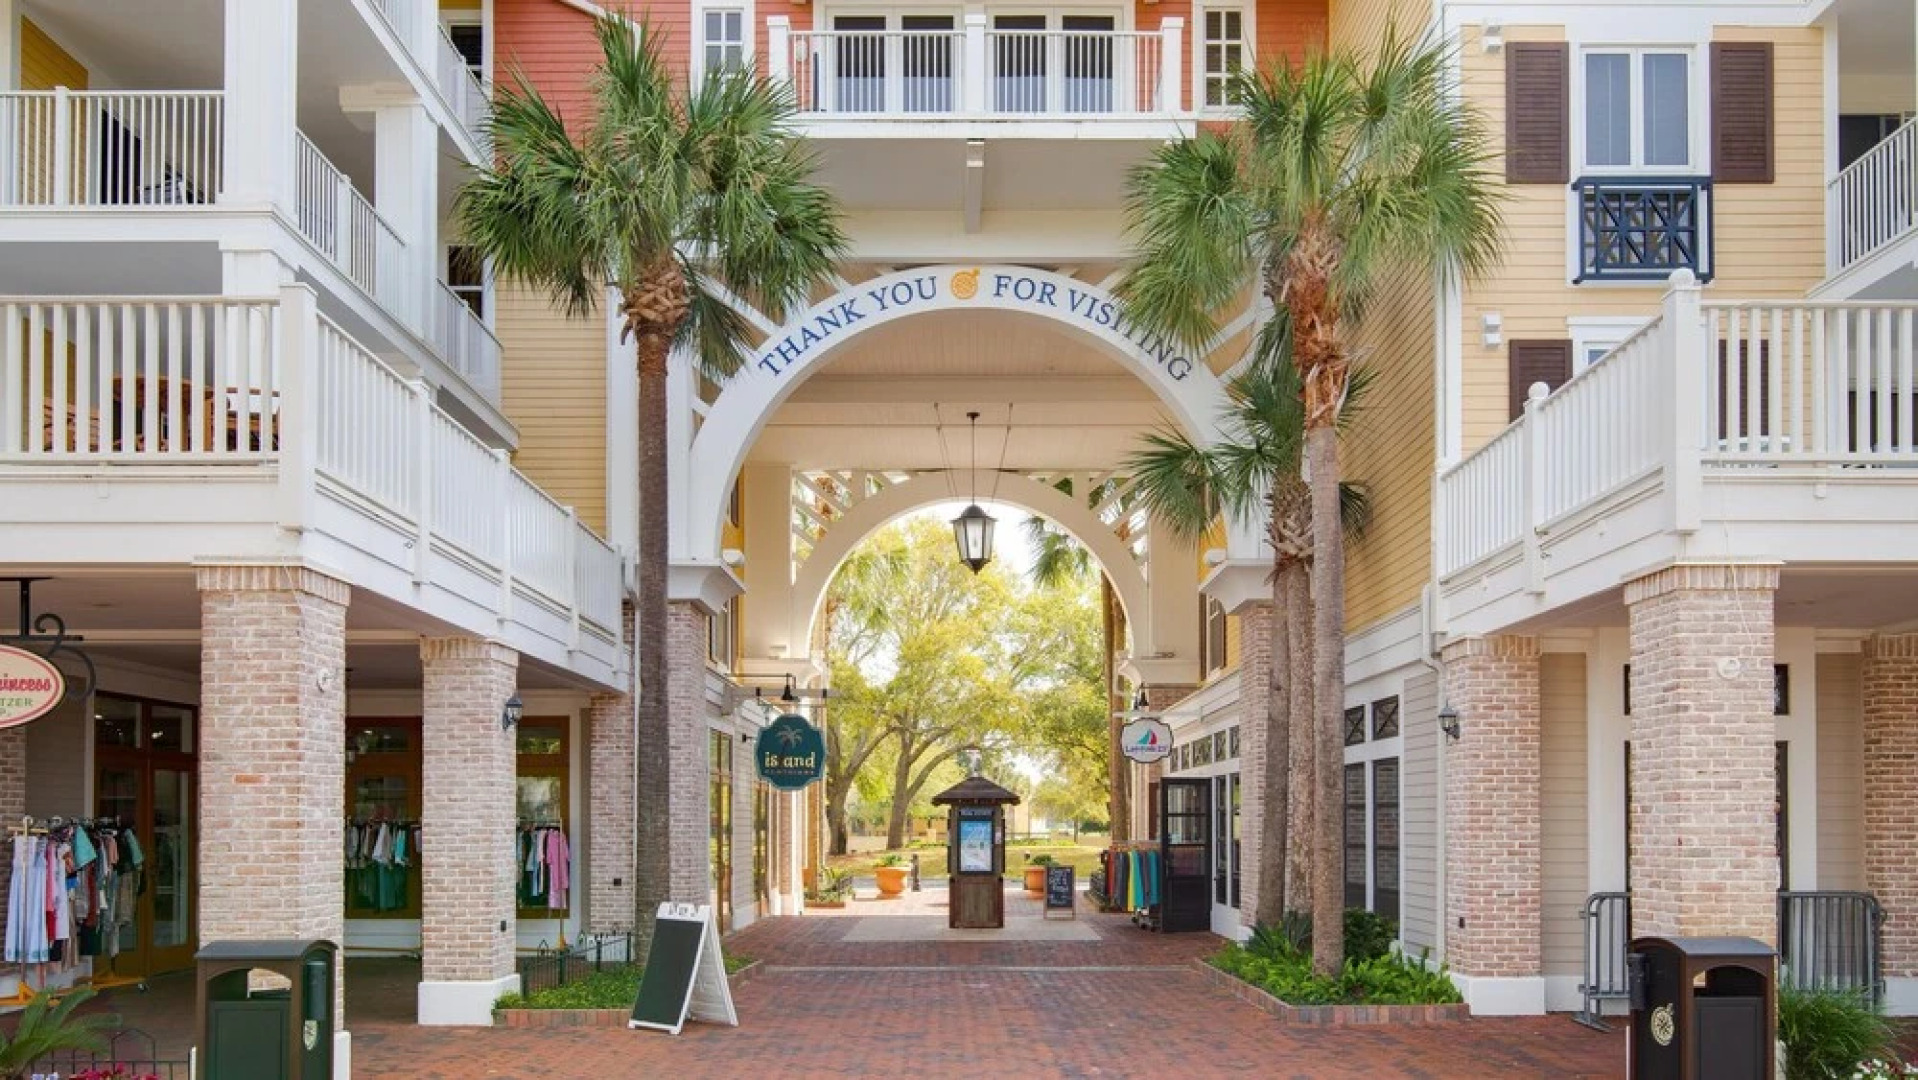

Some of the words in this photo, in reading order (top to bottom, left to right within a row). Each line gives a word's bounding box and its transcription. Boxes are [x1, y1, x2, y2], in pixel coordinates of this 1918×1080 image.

[758, 297, 866, 378] THANK
[868, 276, 938, 312] YOU
[993, 274, 1057, 308] FOR
